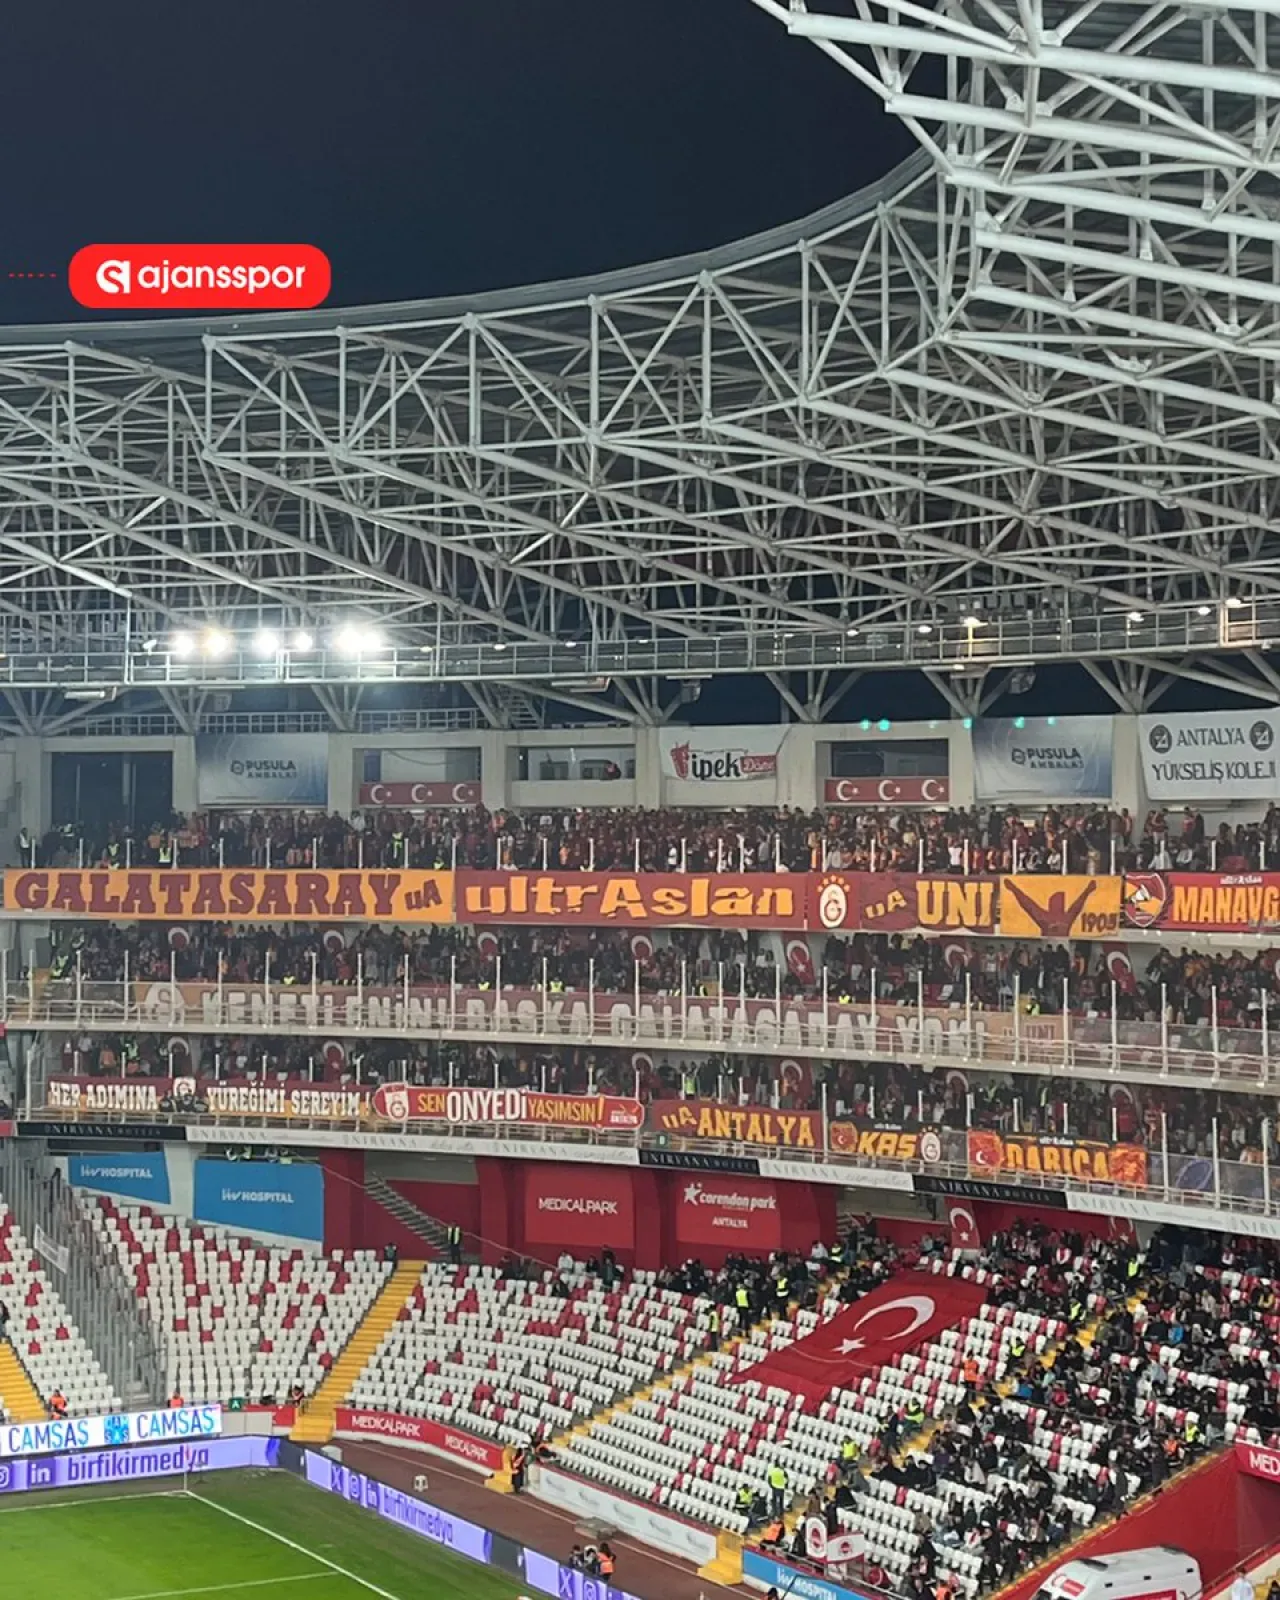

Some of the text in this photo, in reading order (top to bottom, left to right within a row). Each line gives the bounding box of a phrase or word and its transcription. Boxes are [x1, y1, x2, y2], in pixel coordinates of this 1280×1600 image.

[1176, 727, 1246, 746] ANTALYA
[246, 760, 296, 770] PUSULA
[1027, 747, 1082, 759] PUSULA
[691, 752, 741, 781] ipek
[14, 872, 401, 916] GALATASARAY
[465, 876, 793, 918] ultrAslan
[916, 880, 993, 927] UNI
[1081, 912, 1117, 933] 1905
[50, 1081, 158, 1110] HER ADIMINA
[417, 1094, 445, 1113] SEN
[697, 1107, 815, 1147] ANTALYA
[101, 1168, 153, 1179] HOSPITAL
[241, 1192, 294, 1204] HOSPITAL
[750, 1196, 776, 1212] park
[137, 1407, 215, 1439] CAMSAS
[9, 1420, 89, 1453] CAMSAS
